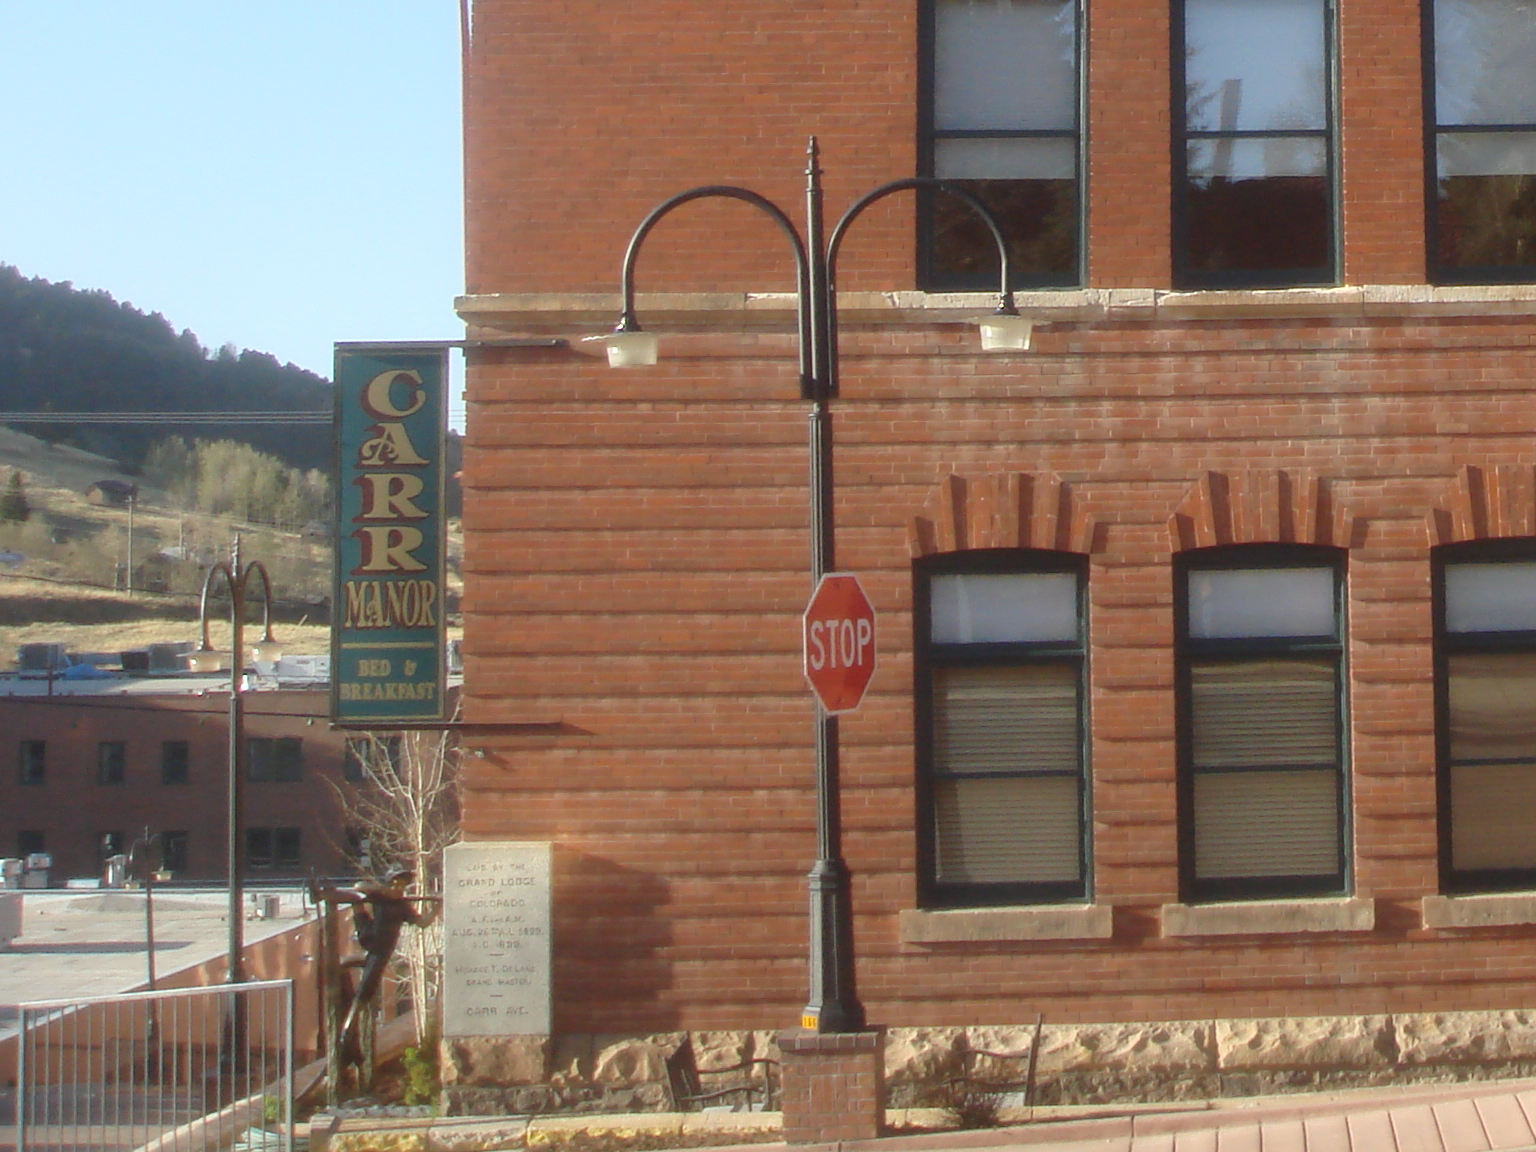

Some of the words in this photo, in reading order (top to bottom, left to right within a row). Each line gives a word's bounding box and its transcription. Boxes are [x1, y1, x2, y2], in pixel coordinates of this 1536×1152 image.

[354, 369, 431, 576] CARR
[345, 580, 437, 628] MANOR
[810, 618, 871, 671] STOP
[358, 659, 392, 677] BED
[404, 659, 418, 676] &
[340, 681, 437, 700] BREAKFAST
[458, 878, 495, 887] GRAND
[501, 876, 535, 886] LODGE
[469, 899, 526, 908] COLORADO
[466, 1007, 497, 1016] CARR
